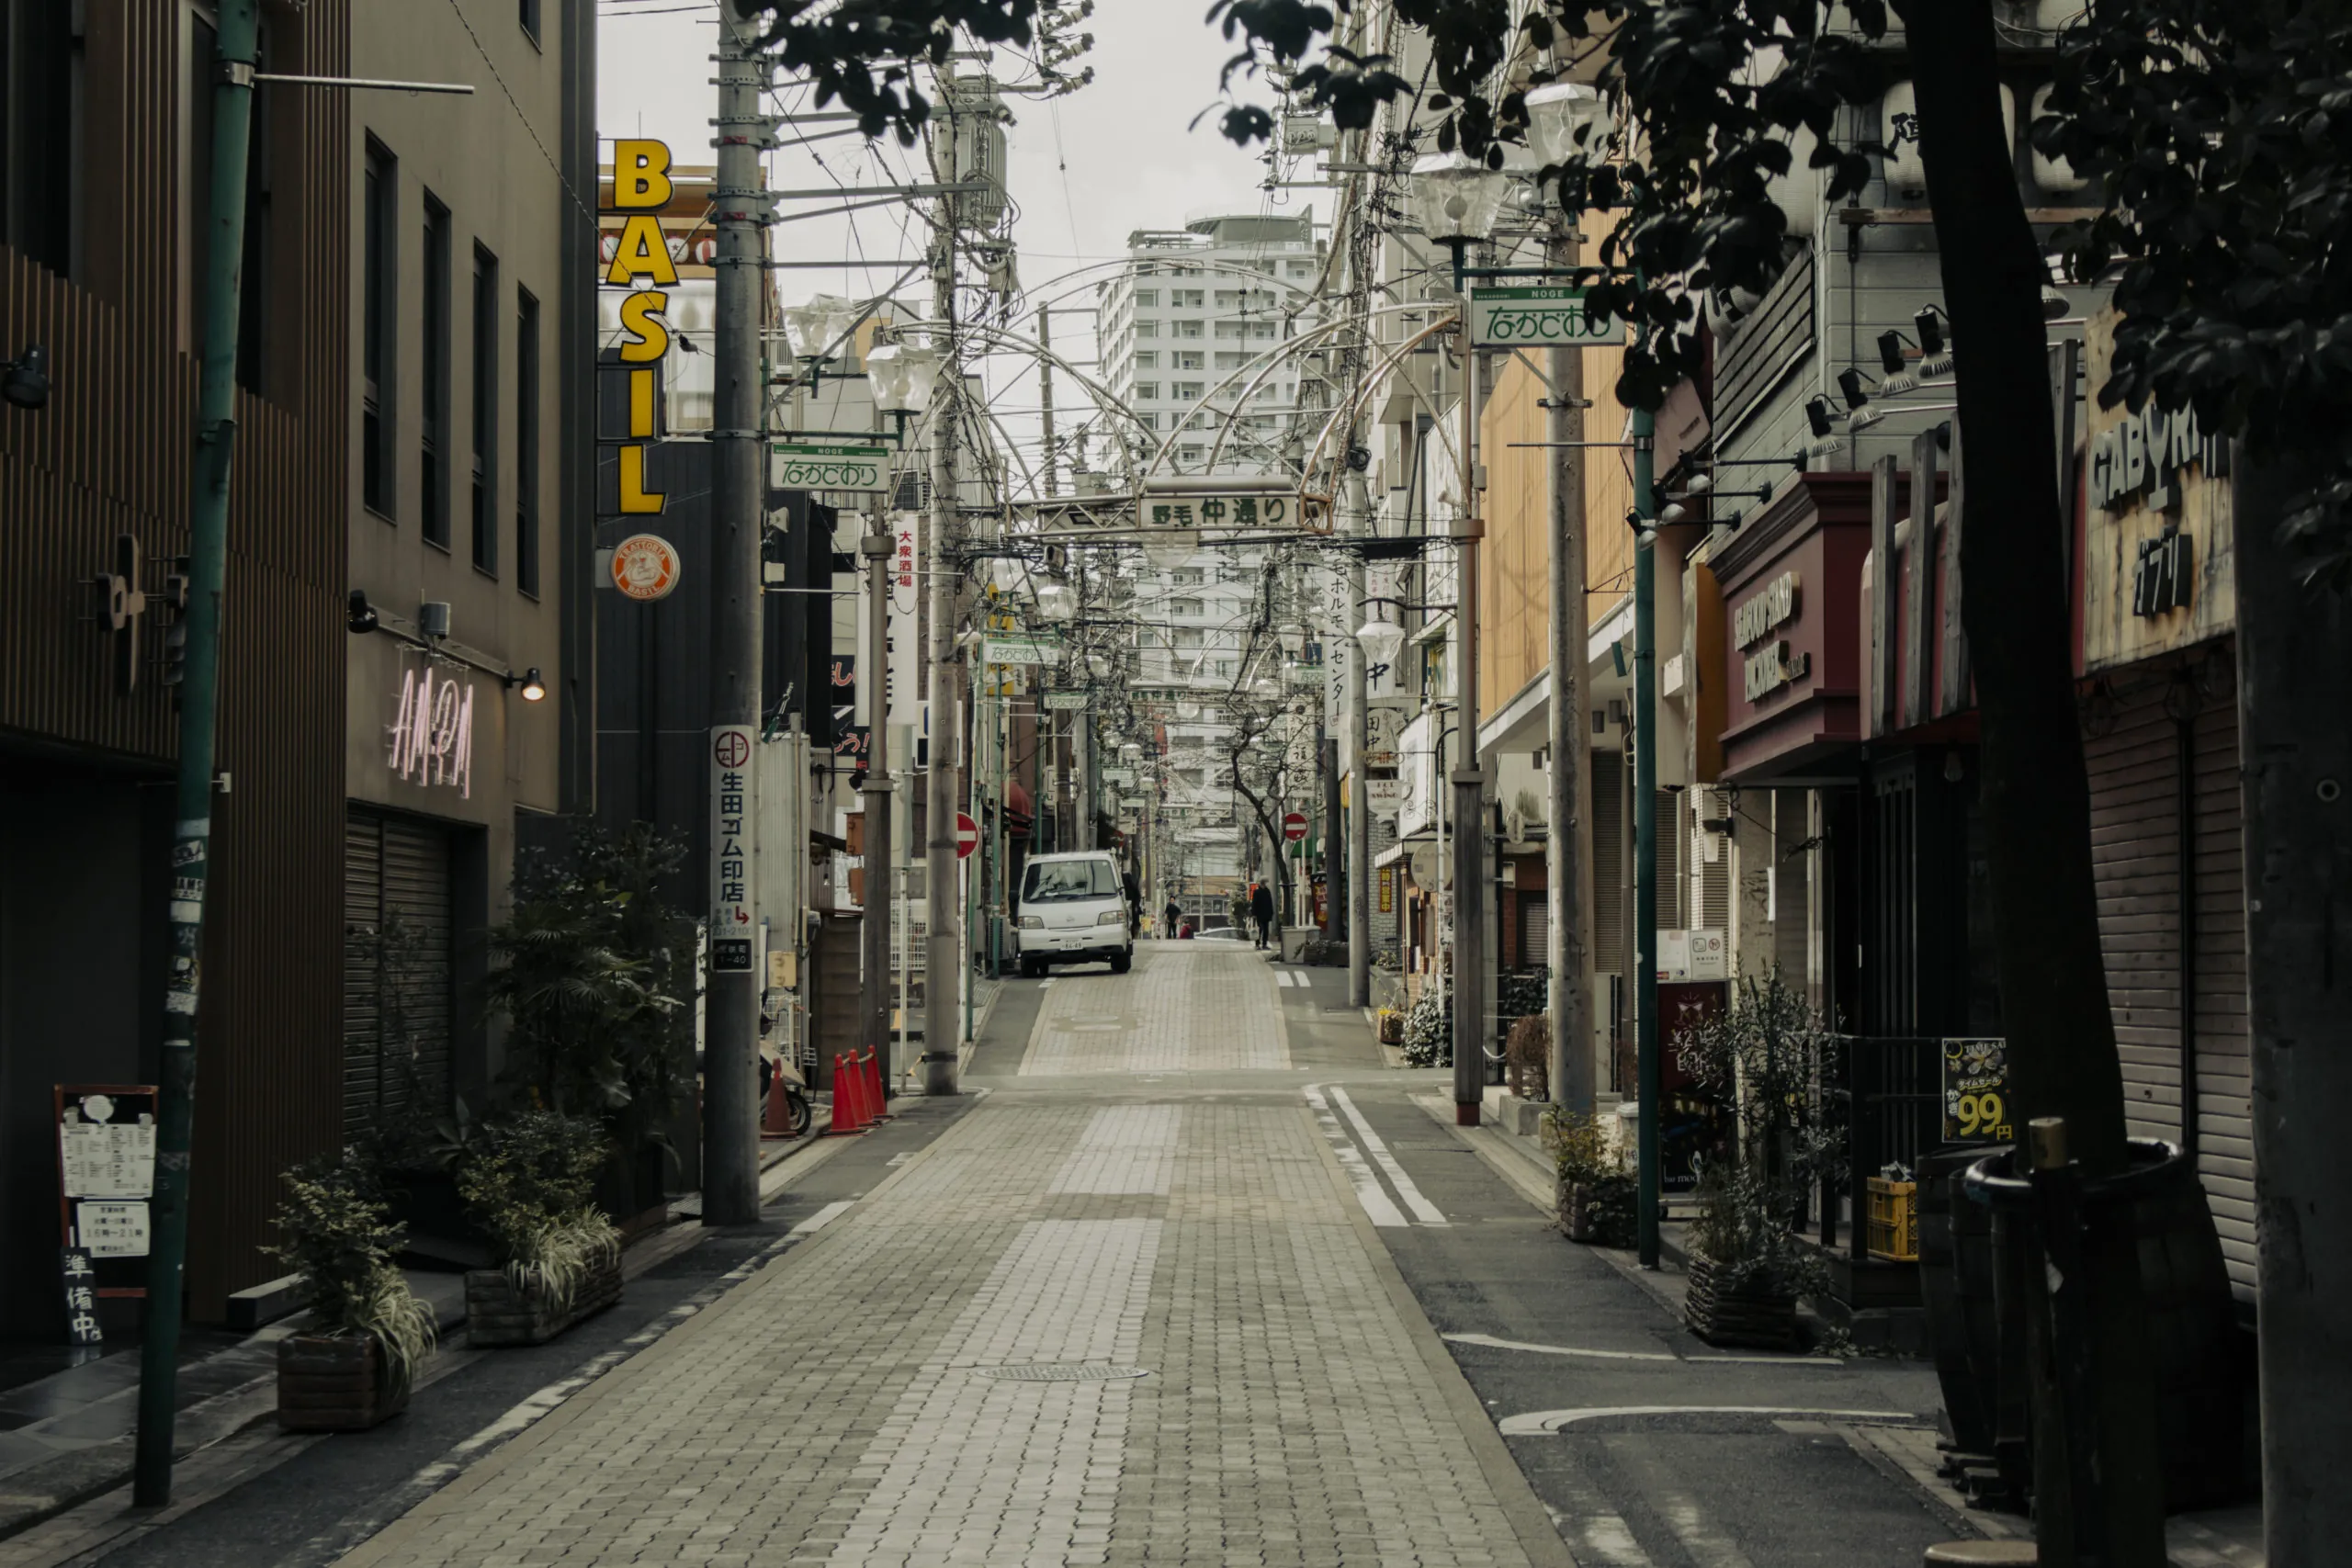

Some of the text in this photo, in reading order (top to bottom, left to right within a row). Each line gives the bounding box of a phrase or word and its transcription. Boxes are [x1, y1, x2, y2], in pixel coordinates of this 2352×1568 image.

[606, 140, 680, 514] BASIL
[783, 459, 877, 486] なかどおり
[1152, 498, 1285, 526] 野毛仲通り
[618, 542, 667, 560] TRATTORIA
[899, 531, 912, 587] 大衆酒場
[628, 585, 659, 596] BASIL
[1329, 549, 1348, 716] 毛ホルモンセンター
[721, 772, 744, 902] 生田ゴム印店
[63, 1254, 95, 1342] 準備中
